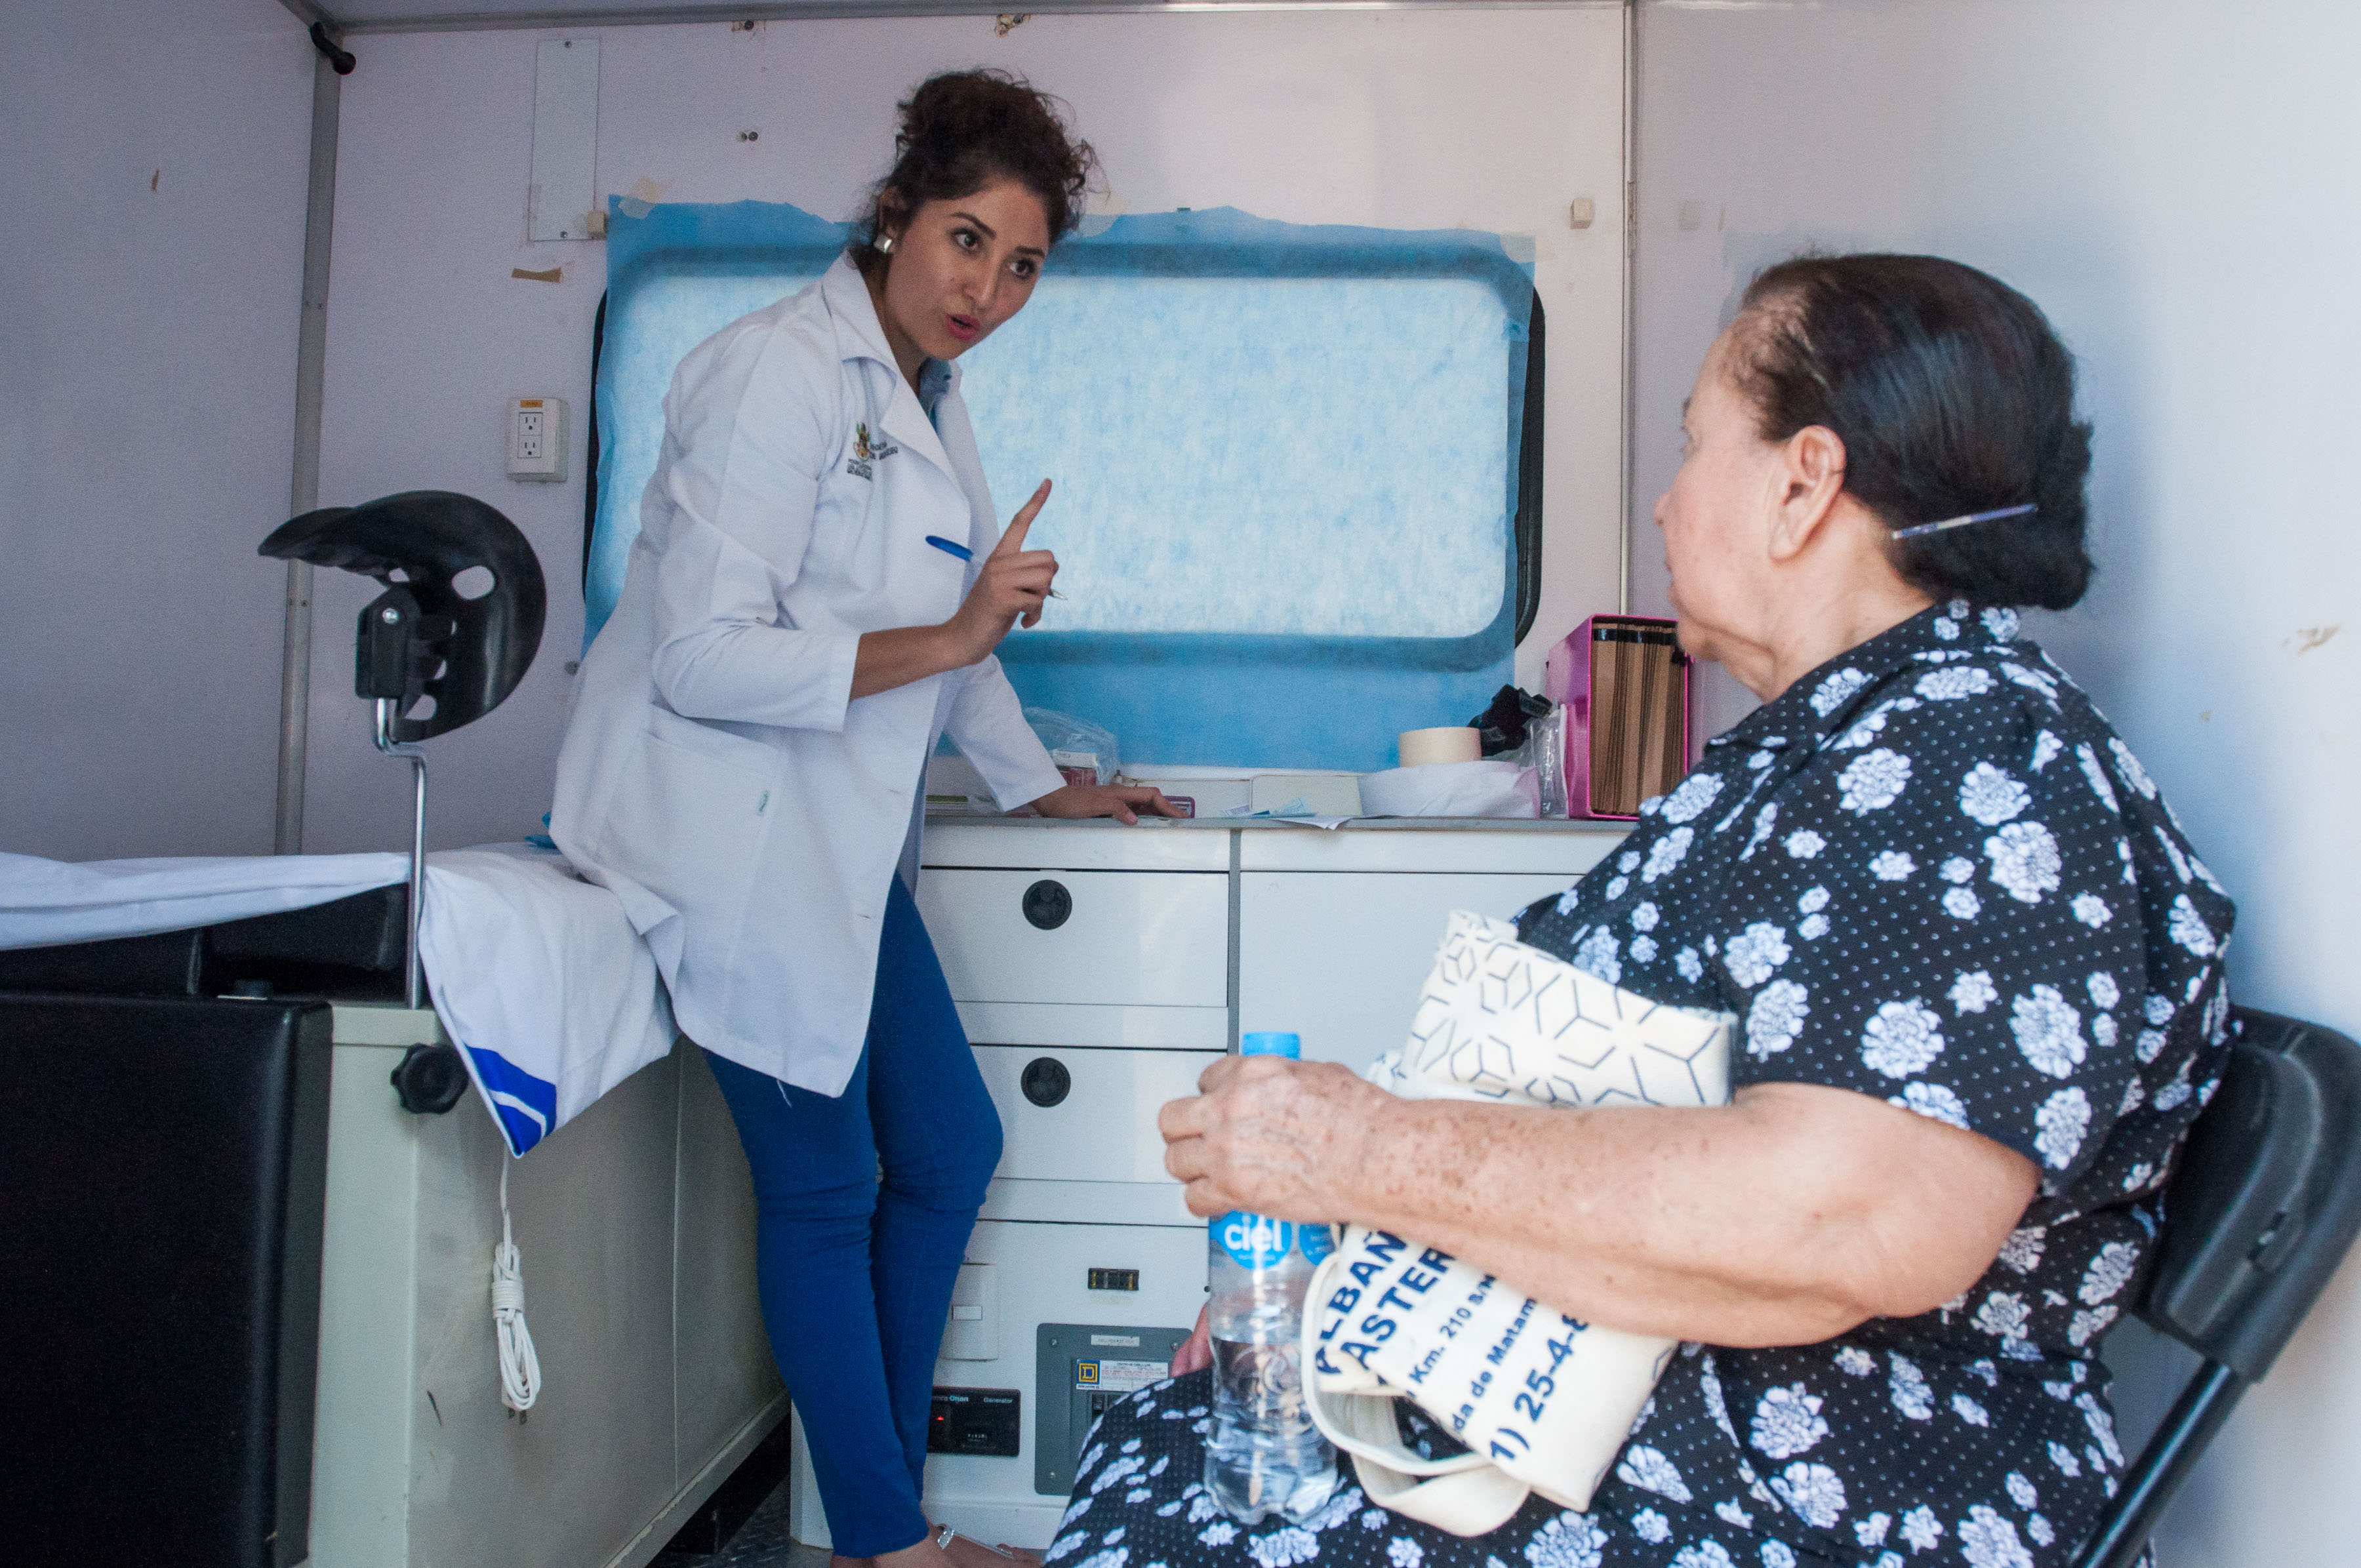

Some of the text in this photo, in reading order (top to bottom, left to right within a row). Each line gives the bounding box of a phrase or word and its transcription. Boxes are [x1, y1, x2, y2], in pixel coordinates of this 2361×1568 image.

[1224, 1214, 1285, 1251] ciel
[1341, 1247, 1456, 1385] ASTER
[1409, 1346, 1445, 1384] Km.
[1440, 1307, 1472, 1338] 210
[1470, 1371, 1493, 1398] de
